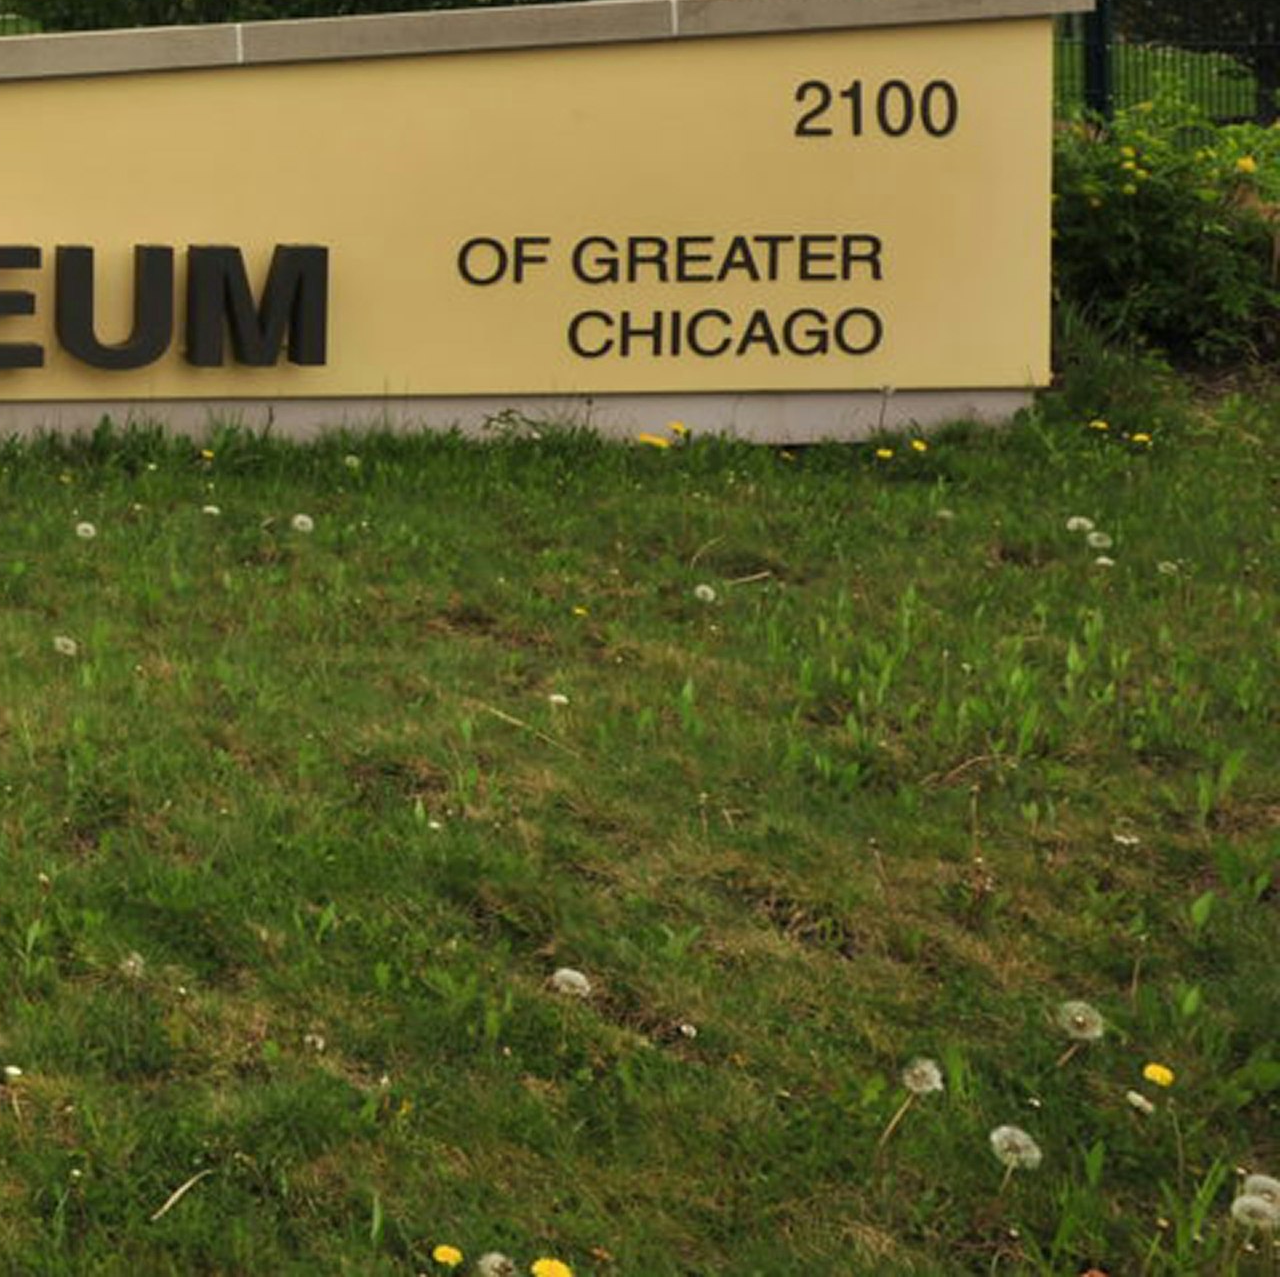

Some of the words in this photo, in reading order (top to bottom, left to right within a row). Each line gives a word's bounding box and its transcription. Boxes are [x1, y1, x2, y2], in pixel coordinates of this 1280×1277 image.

[794, 79, 958, 138] 2100
[457, 236, 551, 287] OF
[572, 234, 883, 285] GREATER
[567, 307, 883, 359] CHICAGO
